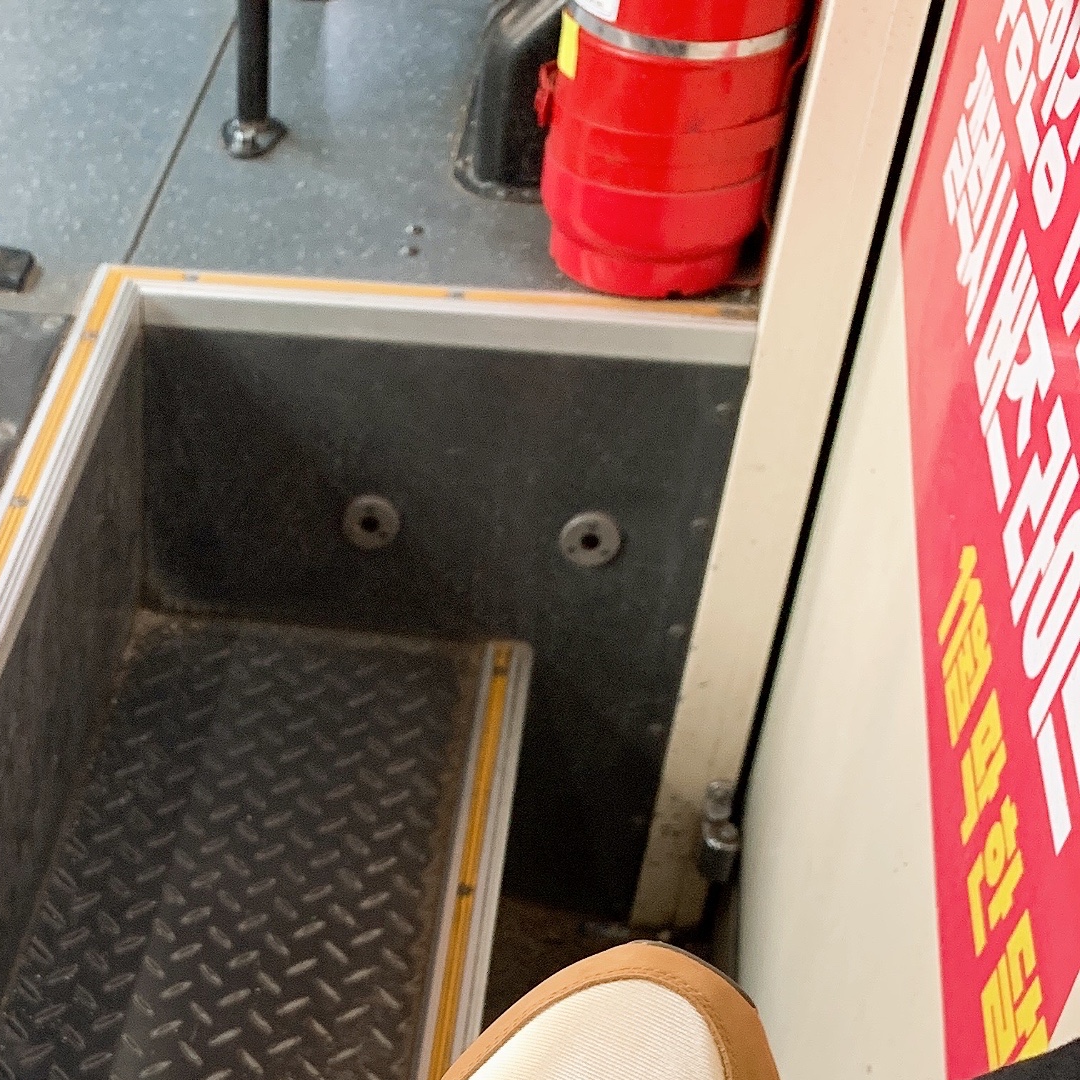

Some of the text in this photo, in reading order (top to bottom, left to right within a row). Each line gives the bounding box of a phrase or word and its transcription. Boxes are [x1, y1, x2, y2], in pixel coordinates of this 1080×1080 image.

[942, 45, 1019, 345] 갤럭시
[974, 228, 1056, 515] 버즈
[937, 545, 993, 750] 11월
[960, 688, 1007, 846] 딱
[967, 794, 1025, 958] 한
